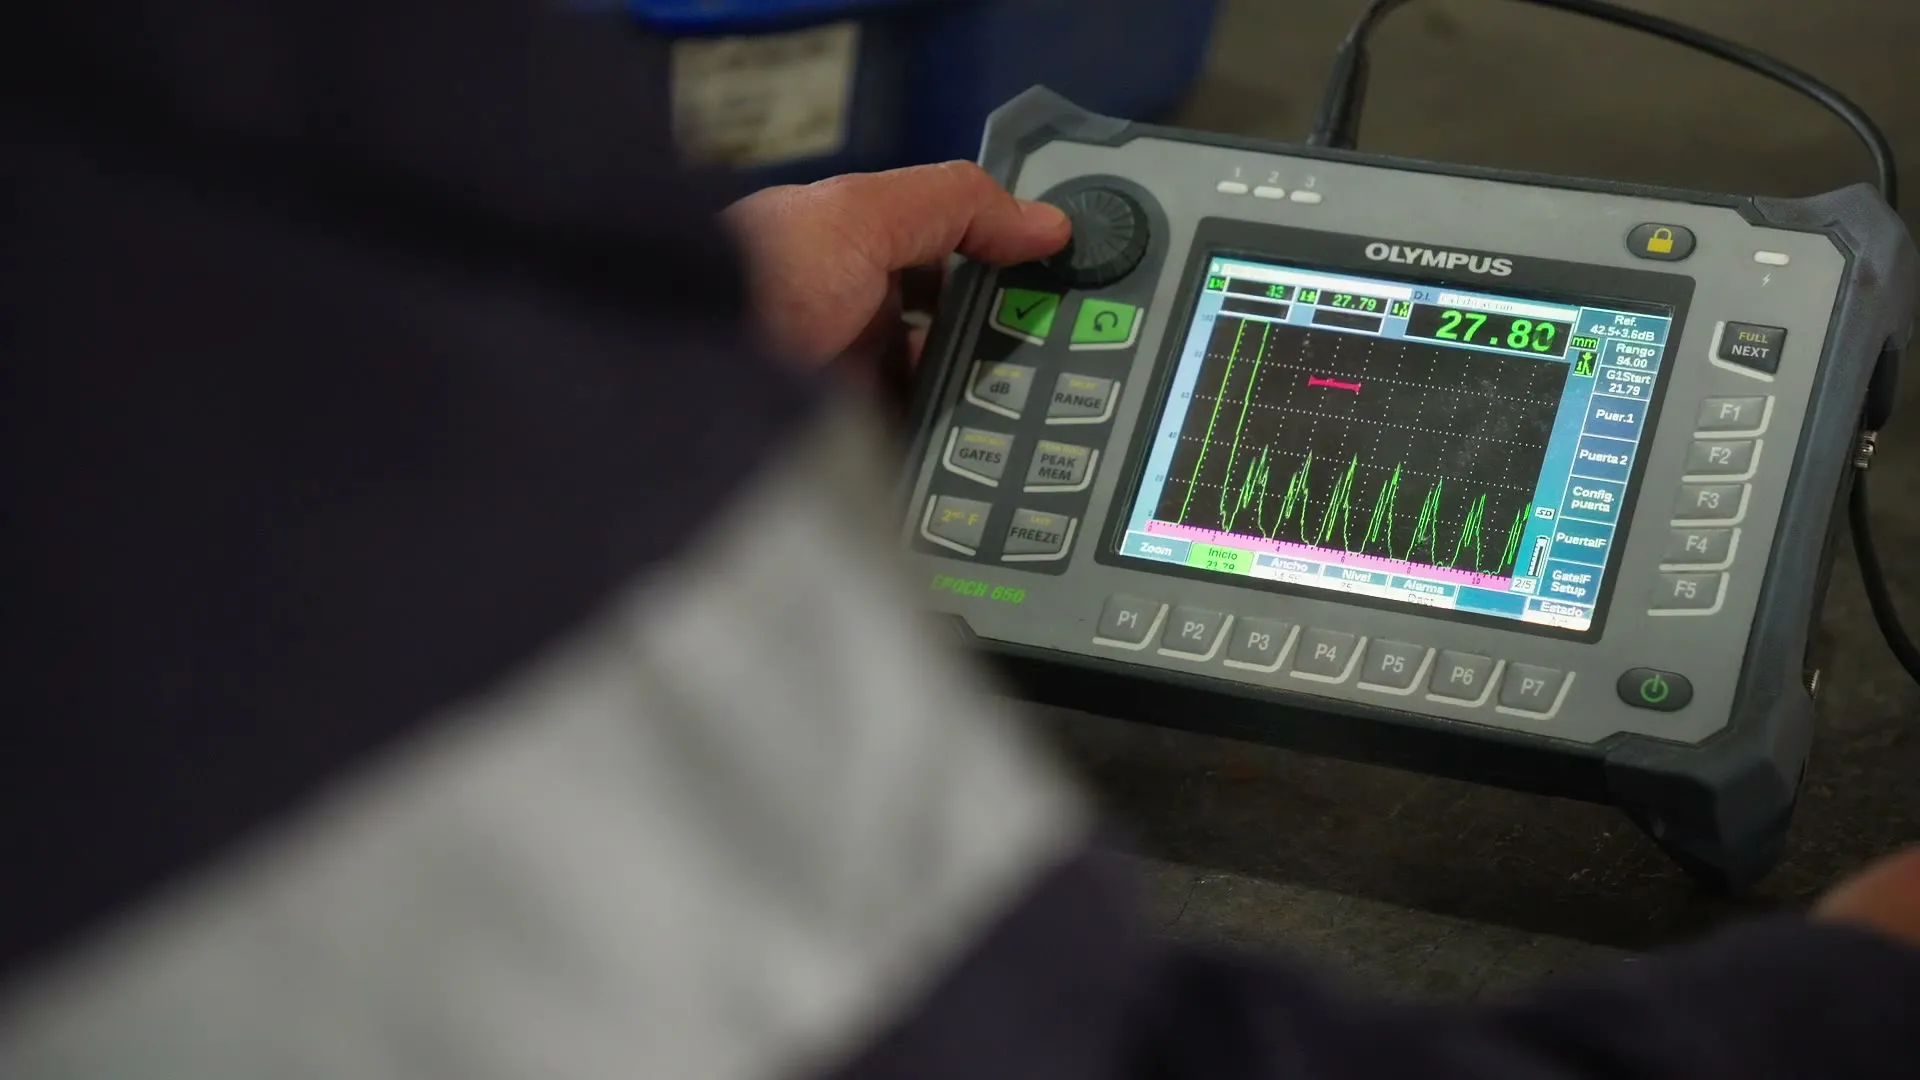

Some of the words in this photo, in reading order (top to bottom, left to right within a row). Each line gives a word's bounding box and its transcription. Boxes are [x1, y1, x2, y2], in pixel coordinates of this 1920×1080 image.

[1267, 170, 1280, 184] 2
[1365, 242, 1513, 277] OLYMPUS
[1332, 295, 1377, 311] 27.79
[1614, 315, 1637, 327] Ref.
[1436, 310, 1556, 352] 27.80
[1738, 331, 1769, 344] FULL
[1572, 337, 1597, 349] mm
[1616, 343, 1655, 358] Rango
[1731, 344, 1770, 359] NEXT
[1606, 369, 1652, 385] G1Start
[990, 382, 1011, 394] dB
[1608, 383, 1641, 396] 21.79
[1054, 392, 1103, 409] RANGE
[1595, 408, 1634, 424] Puer.1
[1719, 403, 1741, 421] F1
[960, 448, 1002, 464] GATES
[1041, 453, 1077, 468] PEAK
[1579, 449, 1618, 465] Puerta
[1619, 455, 1628, 465] 2
[1708, 446, 1731, 465] F2
[1038, 468, 1072, 481] MEM
[1572, 486, 1615, 502] Config.
[1697, 490, 1720, 509] F3
[1571, 499, 1610, 512] puerta
[1010, 527, 1060, 544] FREEZE
[1139, 541, 1172, 556] Zoom
[1685, 535, 1708, 554] F4
[1208, 547, 1238, 560] Inicio
[1270, 558, 1308, 572] Ancho
[1342, 569, 1371, 582] Nivel
[933, 574, 990, 597] EPOCH
[991, 586, 1027, 604] 650
[1403, 580, 1444, 595] Alarma
[1514, 579, 1532, 589] 2/5
[1550, 582, 1586, 597] Setup
[1674, 580, 1697, 599] F5
[1540, 601, 1583, 617] Estado
[1116, 610, 1138, 629] P1
[1181, 621, 1205, 640] P2
[1247, 632, 1270, 650] P3
[1314, 643, 1337, 662] P4
[1381, 654, 1405, 673] P5
[1450, 666, 1474, 685] P6
[1520, 677, 1545, 697] P7
